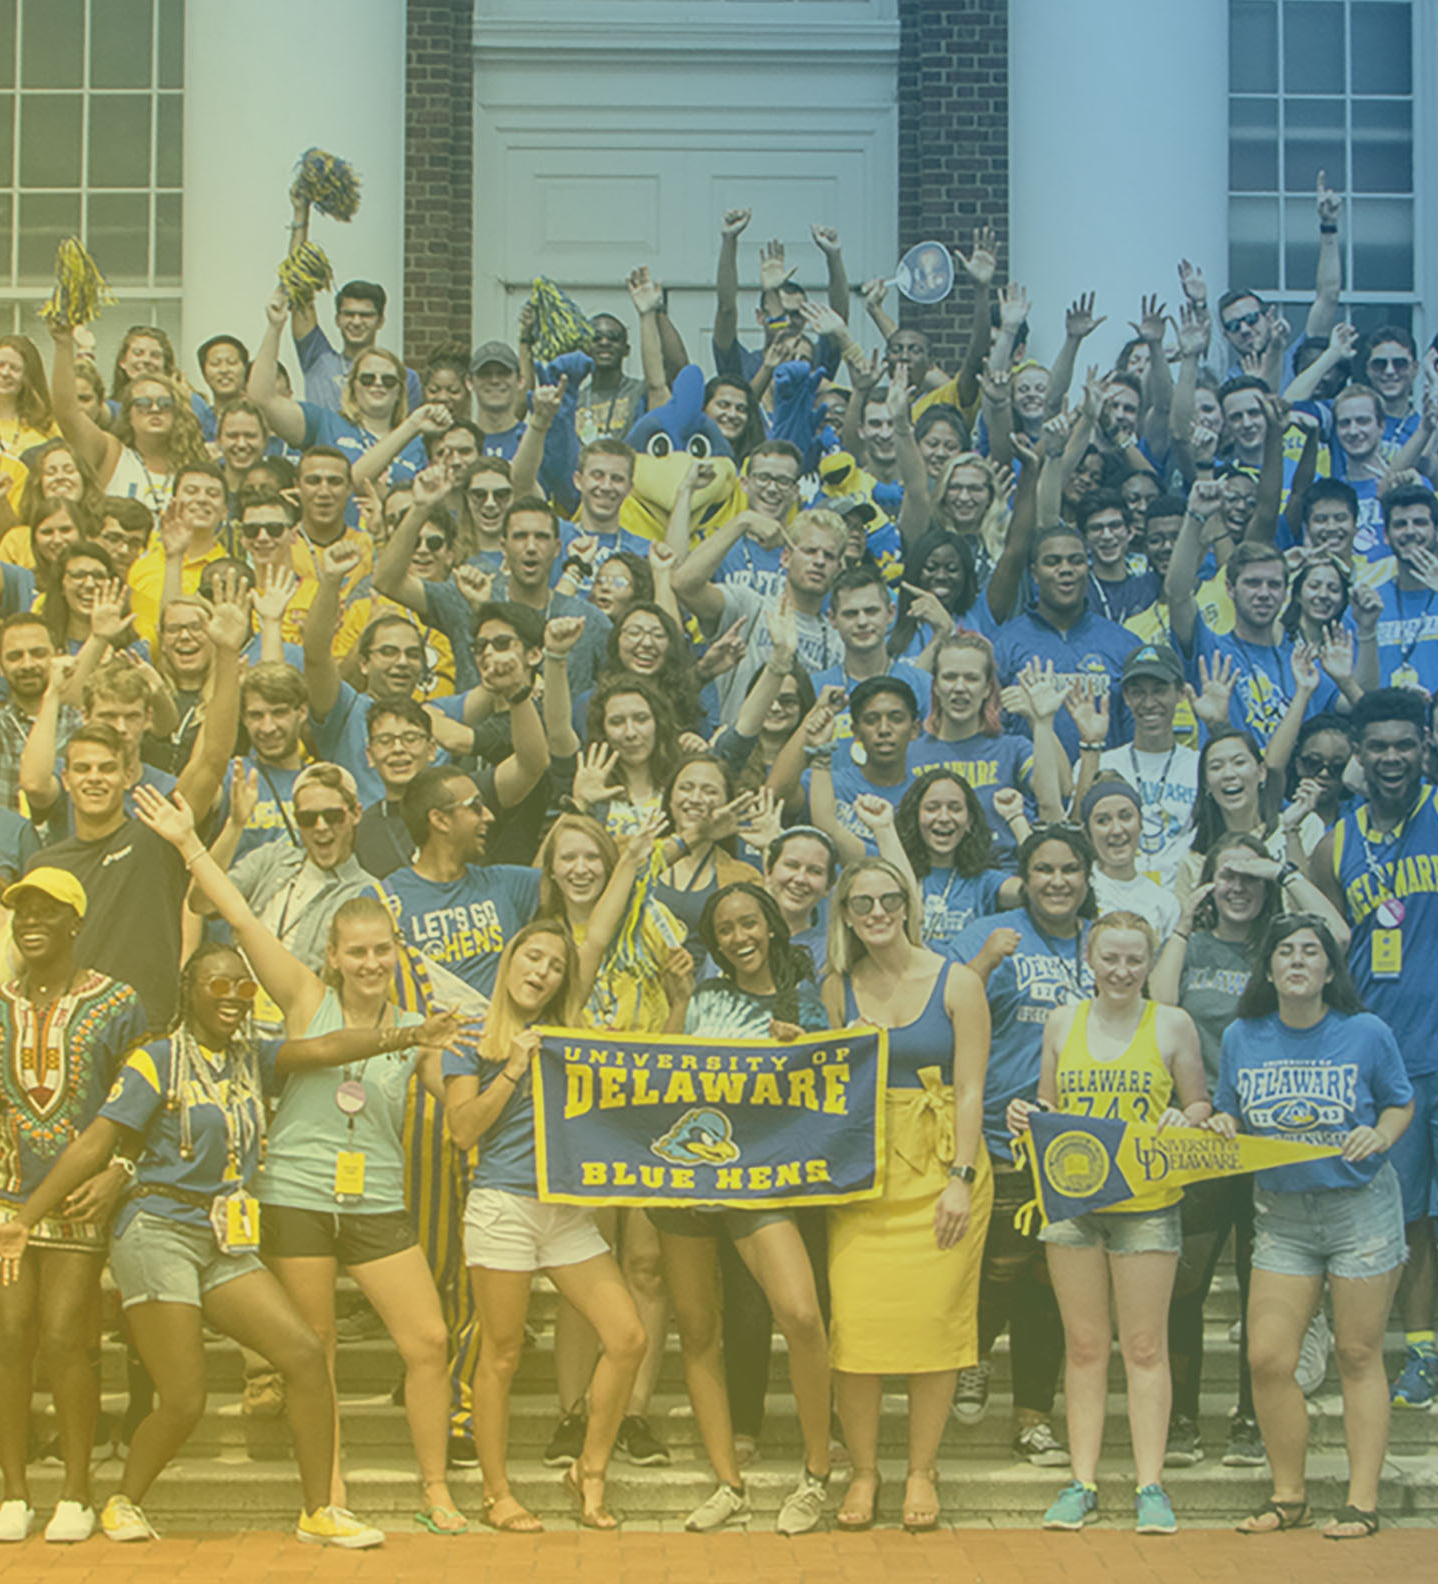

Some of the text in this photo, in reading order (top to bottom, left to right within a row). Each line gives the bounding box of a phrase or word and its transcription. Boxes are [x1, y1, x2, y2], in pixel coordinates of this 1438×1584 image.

[411, 899, 499, 942] LET'S GO
[443, 923, 503, 963] HENS
[563, 1045, 851, 1072] UNIVERSITY OF
[563, 1062, 852, 1121] DELAWARE
[1238, 1064, 1358, 1113] DELAWARE
[580, 1158, 832, 1191] BLUE HENS
